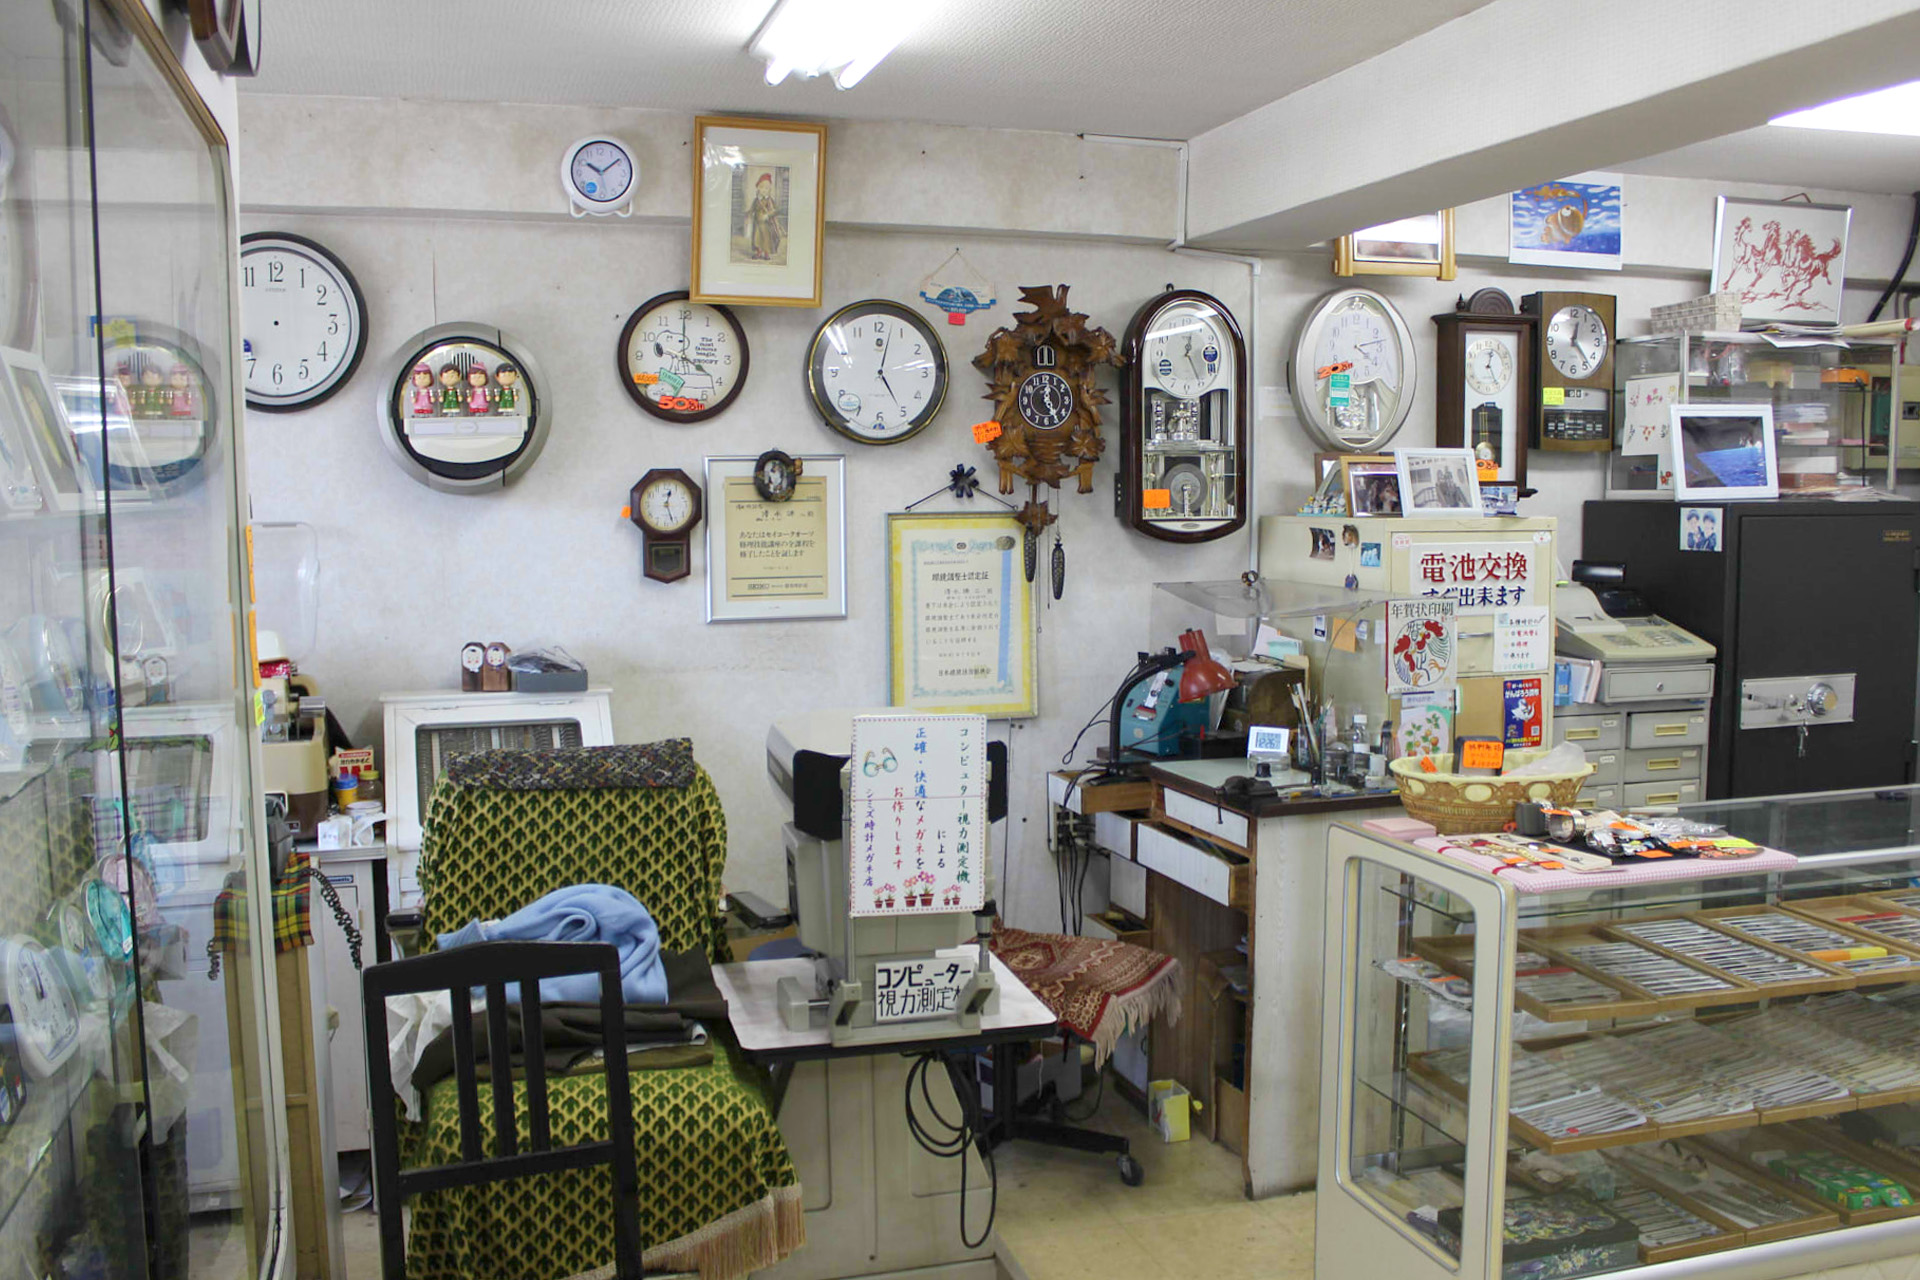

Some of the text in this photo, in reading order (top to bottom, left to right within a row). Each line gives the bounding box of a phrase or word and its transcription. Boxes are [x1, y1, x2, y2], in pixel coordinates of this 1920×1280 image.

[244, 267, 255, 287] 11
[268, 261, 284, 282] 12
[300, 268, 305, 288] 1
[317, 284, 327, 306] 2
[679, 309, 692, 320] 12
[1570, 309, 1579, 318] 12
[1584, 314, 1587, 322] 1
[328, 314, 338, 335] 3
[658, 316, 669, 327] 11
[705, 316, 710, 327] 1
[853, 327, 862, 339] 11
[874, 322, 884, 333] 12
[1550, 323, 1559, 332] 10
[1592, 324, 1597, 333] 2
[643, 332, 656, 342] 10
[718, 332, 726, 343] 2
[900, 328, 903, 339] 1
[1547, 336, 1554, 345] 9
[1594, 338, 1600, 347] 3
[317, 341, 328, 362] 4
[635, 350, 643, 360] 9
[914, 344, 921, 355] 2
[1551, 350, 1557, 359] 8
[723, 355, 732, 365] 3
[1590, 352, 1596, 361] 4
[246, 358, 257, 379] 7
[299, 359, 309, 379] 5
[1559, 361, 1565, 370] 7
[1570, 364, 1577, 374] 6
[1582, 361, 1588, 371] 5
[272, 363, 283, 385] 6
[921, 367, 928, 378] 3
[715, 376, 723, 387] 4
[1033, 377, 1039, 386] 11
[1042, 375, 1049, 384] 12
[1053, 377, 1057, 386] 1
[1025, 385, 1033, 394] 10
[1060, 384, 1065, 392] 2
[1022, 396, 1028, 405] 9
[1064, 396, 1069, 405] 3
[876, 411, 884, 422] 6
[900, 406, 907, 417] 5
[1061, 408, 1066, 417] 4
[1035, 415, 1039, 423] 7
[1043, 416, 1050, 425] 6
[1420, 552, 1527, 583] 電池交換
[1390, 601, 1454, 619] 年賀状印刷
[892, 787, 904, 870] お作りします
[878, 964, 971, 989] コンピューター
